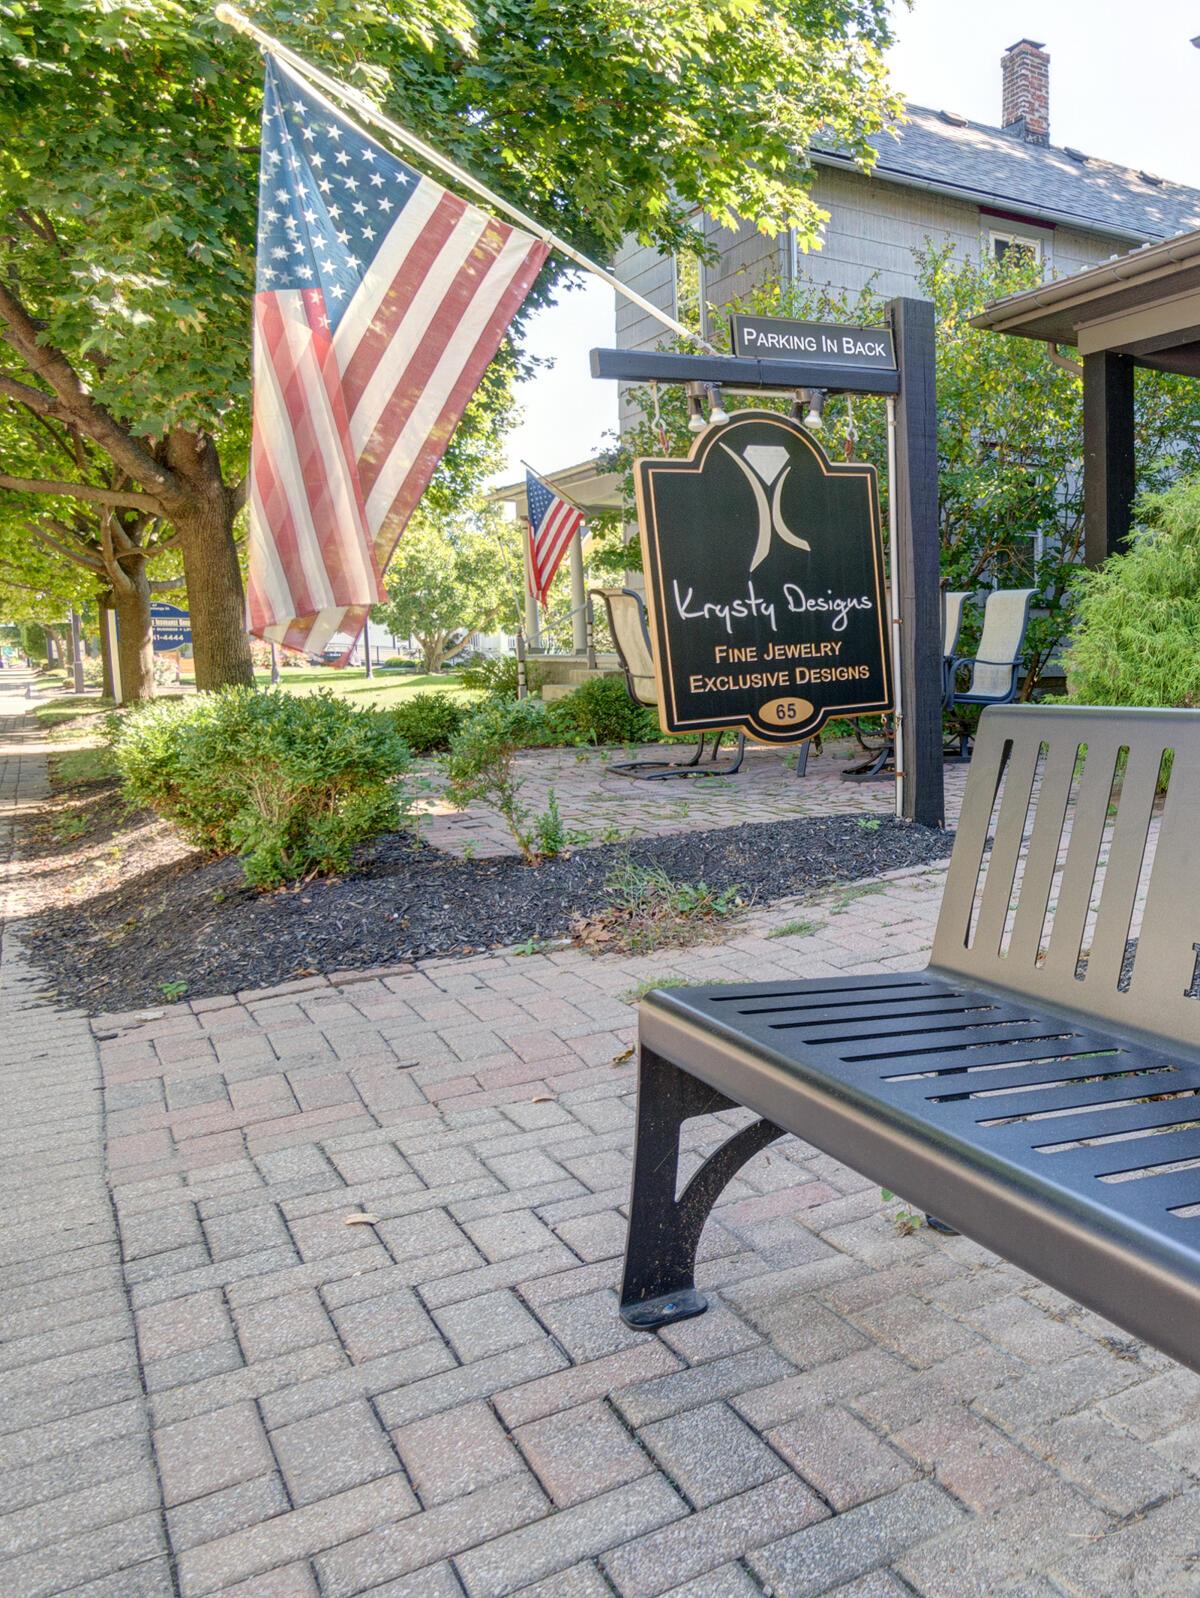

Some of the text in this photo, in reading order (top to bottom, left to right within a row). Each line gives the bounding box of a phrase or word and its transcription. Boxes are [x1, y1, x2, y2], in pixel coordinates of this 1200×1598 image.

[743, 328, 886, 356] PARKING IN BACK
[673, 579, 873, 634] Krysty Designs
[714, 641, 842, 664] FINE JEWELRY
[689, 665, 870, 694] EXCLUSIVE DESIGNS
[775, 703, 797, 720] 65
